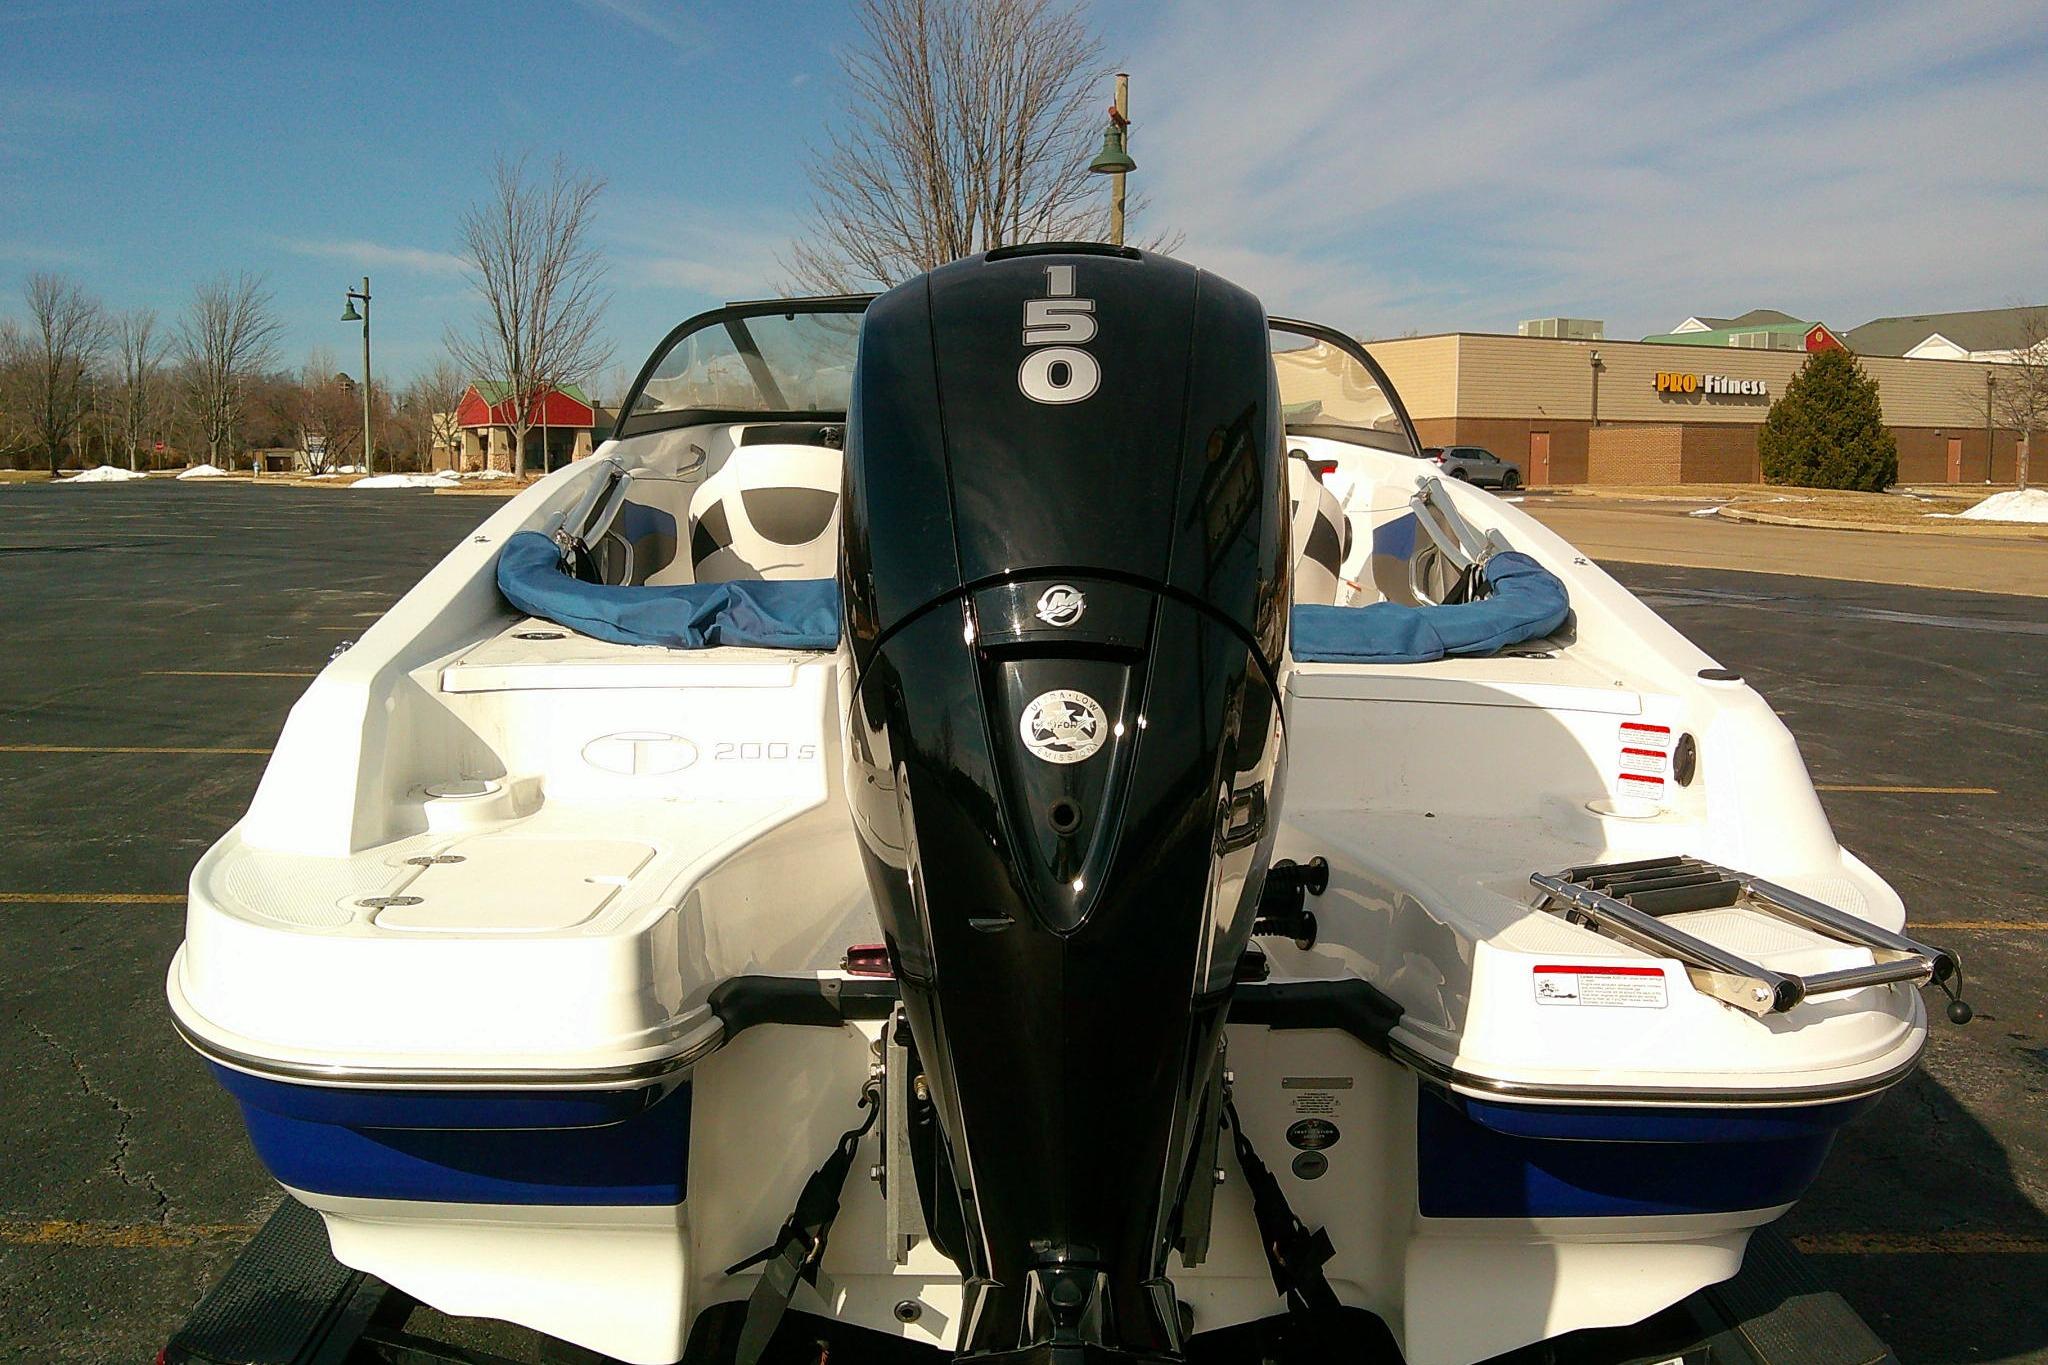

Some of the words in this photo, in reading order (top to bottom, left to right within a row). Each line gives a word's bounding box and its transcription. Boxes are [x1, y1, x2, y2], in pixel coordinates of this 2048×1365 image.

[1017, 264, 1102, 405] 150
[1656, 372, 1698, 393] PRO
[1703, 374, 1767, 395] Fitness
[1075, 694, 1099, 712] LOW
